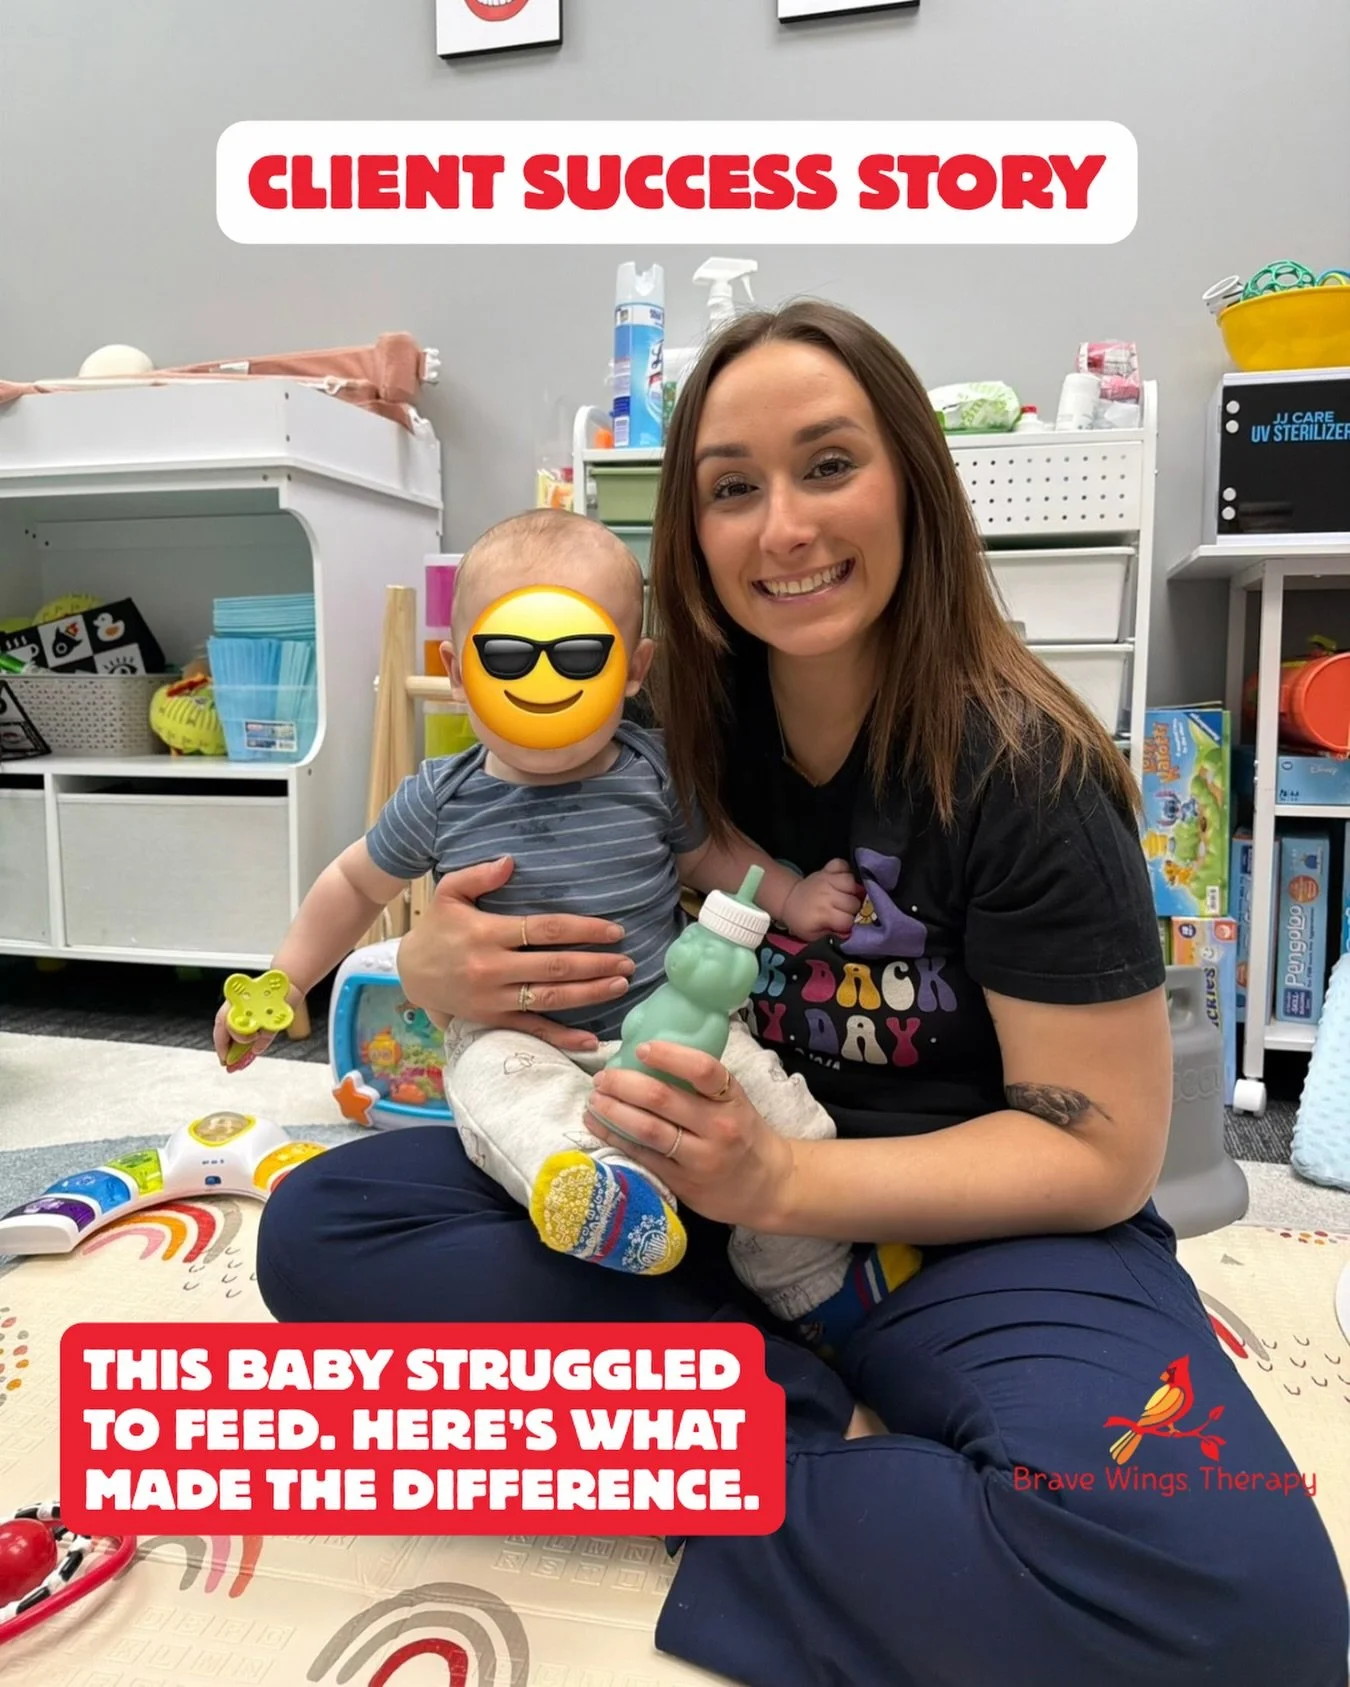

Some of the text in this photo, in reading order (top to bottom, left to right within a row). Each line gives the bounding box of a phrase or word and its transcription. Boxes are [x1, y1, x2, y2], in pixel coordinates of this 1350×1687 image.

[1272, 410, 1335, 425] JJ CARE
[1251, 425, 1272, 443] UV
[804, 1008, 921, 1067] DAY
